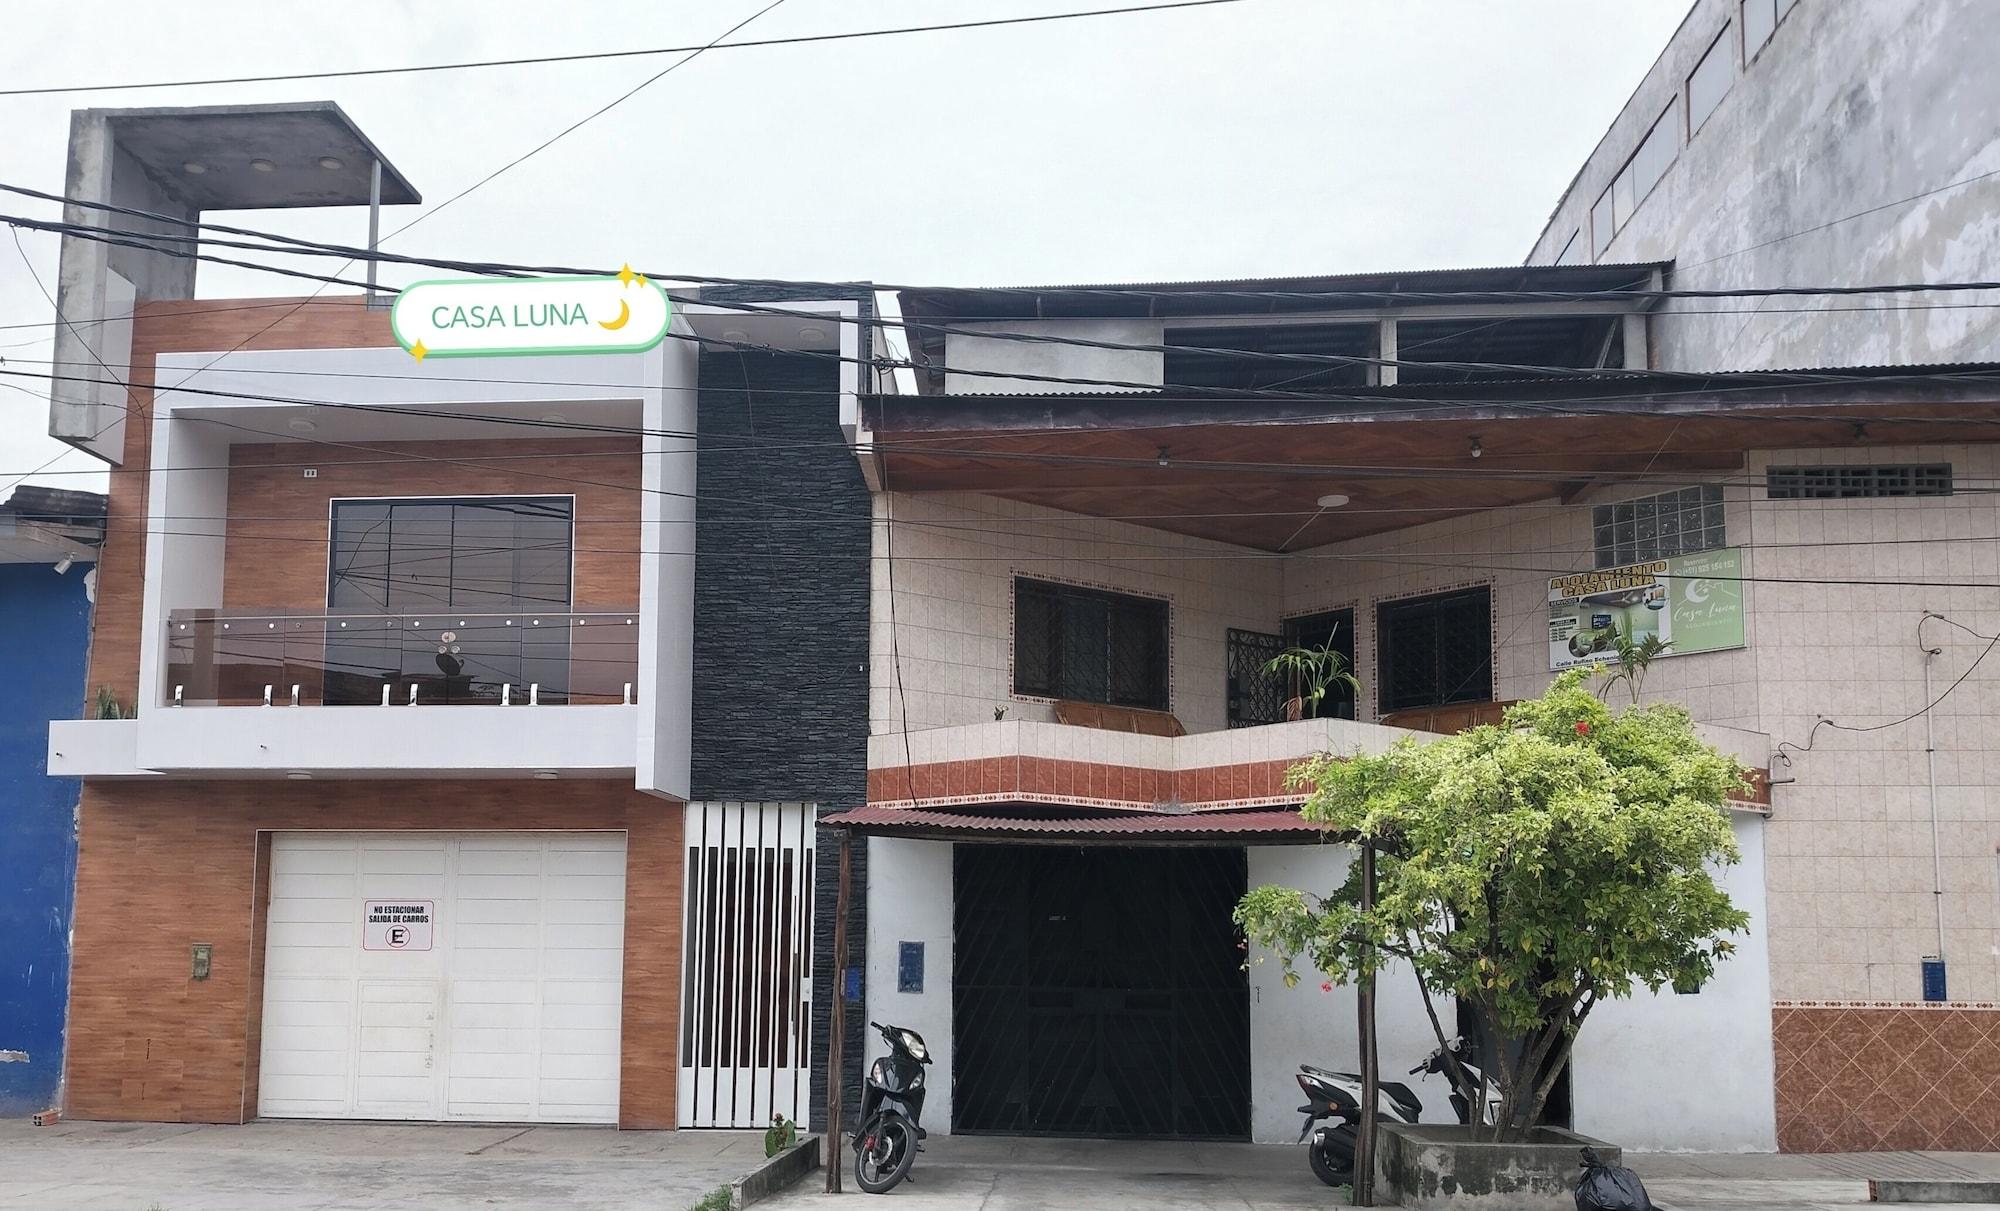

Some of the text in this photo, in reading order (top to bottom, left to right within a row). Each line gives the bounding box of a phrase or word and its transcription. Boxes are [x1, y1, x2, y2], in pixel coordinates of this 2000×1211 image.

[1550, 560, 1667, 589] ALOJAMIENTO
[1561, 576, 1657, 597] CASA LUNA
[1673, 606, 1703, 622] Casa
[1573, 657, 1593, 665] Rufino
[1594, 654, 1619, 663] Echeni
[374, 906, 424, 914] NO ESTACIONAR
[369, 915, 429, 923] SALIDA DE CARROS
[392, 929, 404, 944] E
